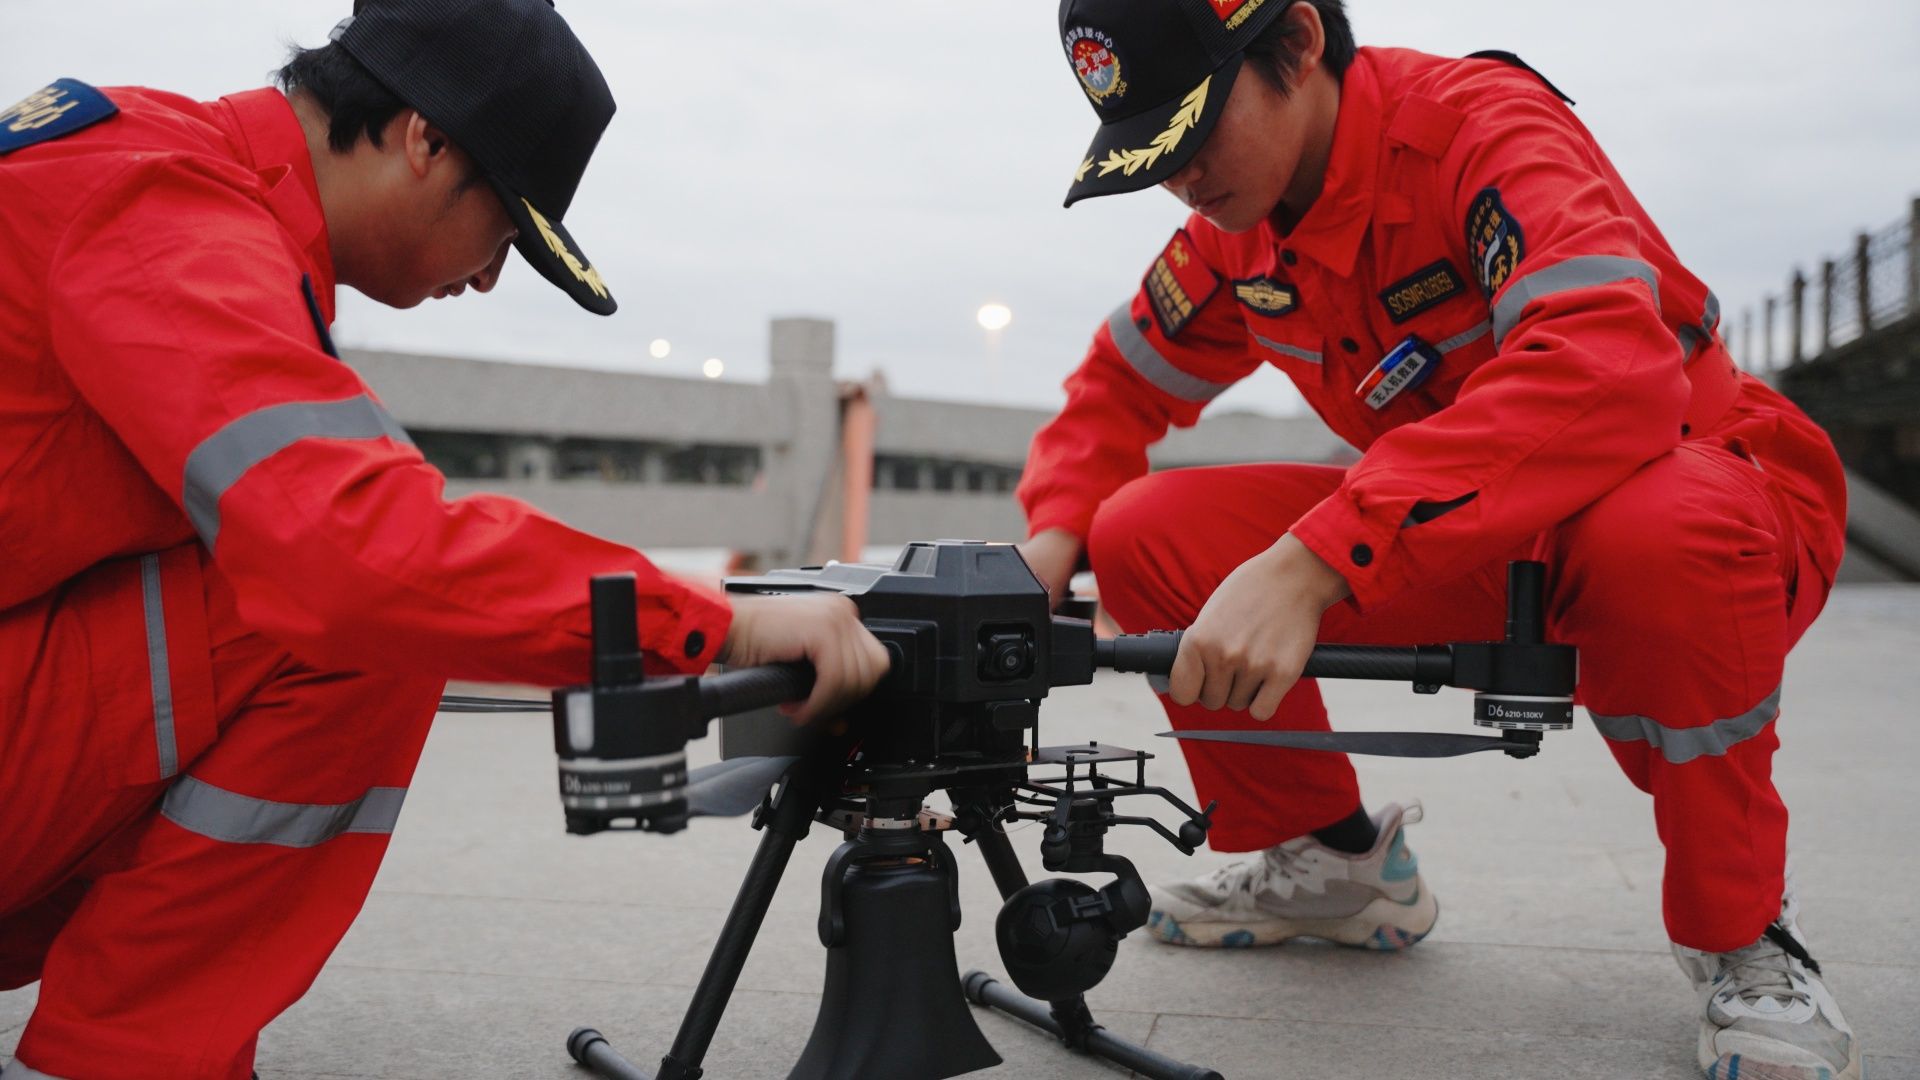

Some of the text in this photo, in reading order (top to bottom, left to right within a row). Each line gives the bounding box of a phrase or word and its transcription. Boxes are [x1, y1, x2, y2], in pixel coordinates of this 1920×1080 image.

[1371, 357, 1420, 404] 无人机救援
[1488, 704, 1504, 717] D6
